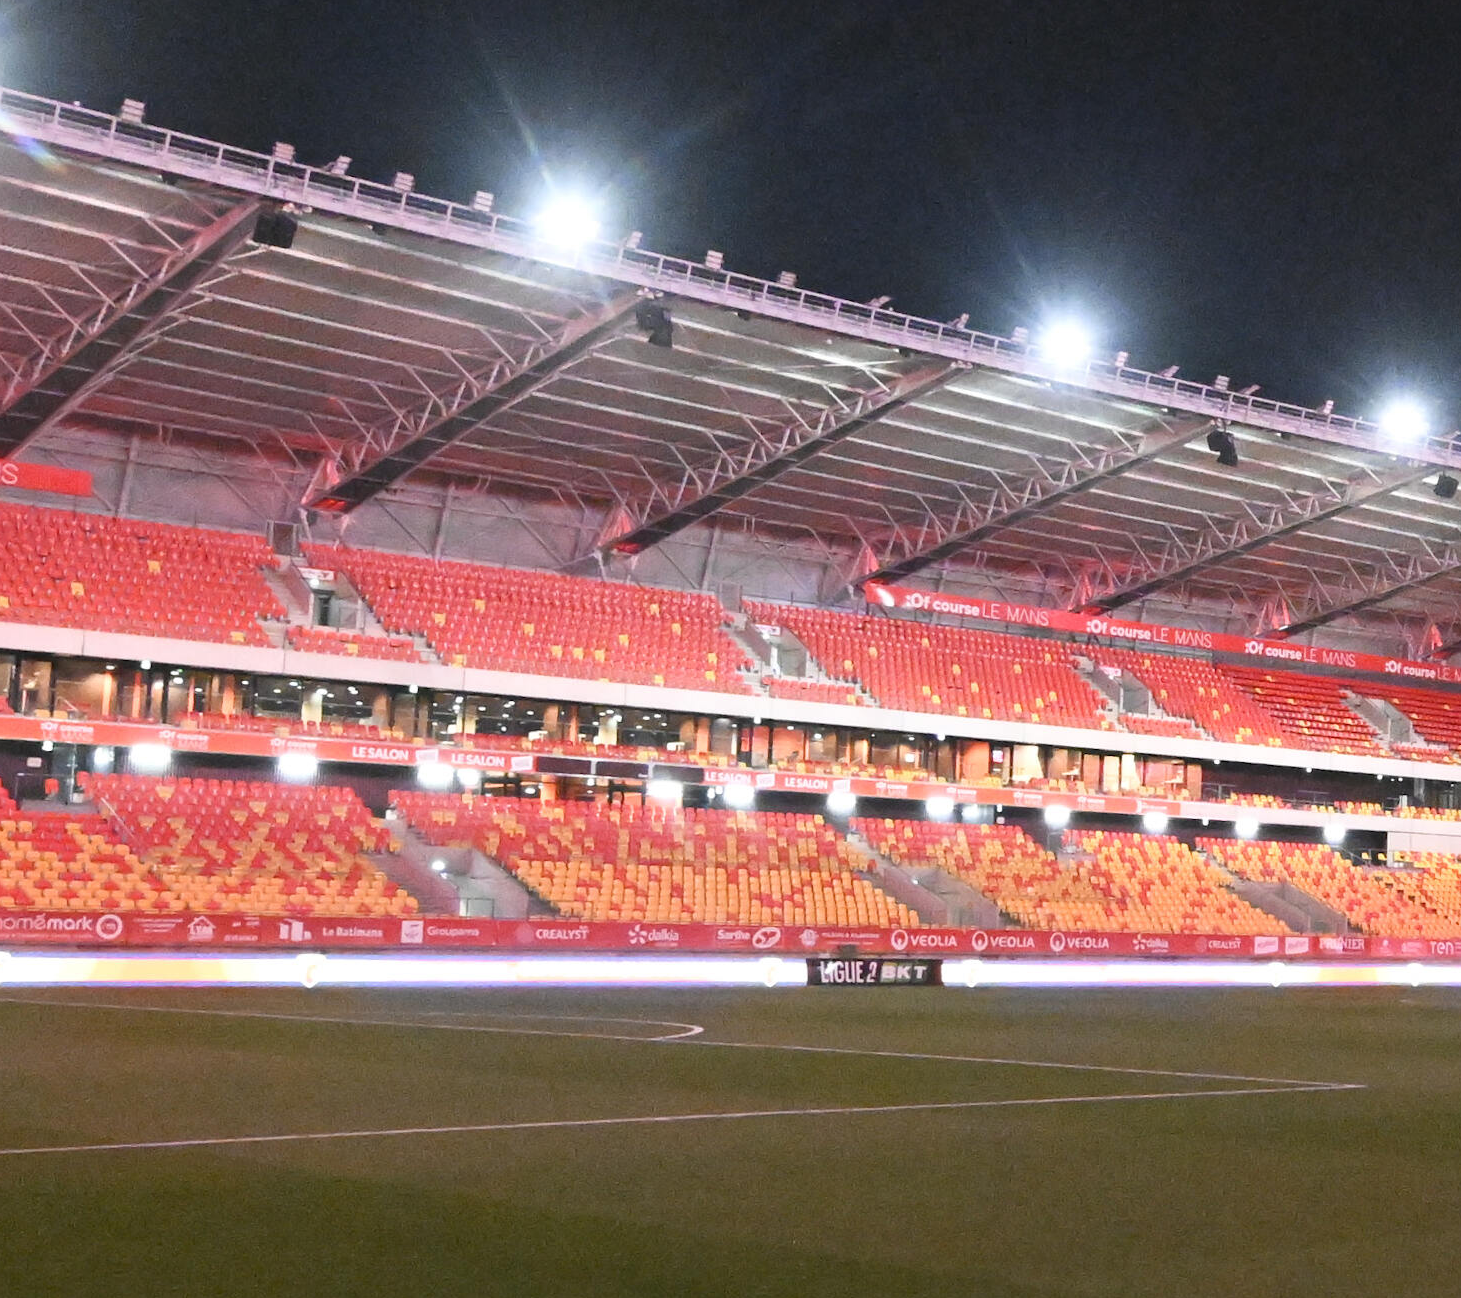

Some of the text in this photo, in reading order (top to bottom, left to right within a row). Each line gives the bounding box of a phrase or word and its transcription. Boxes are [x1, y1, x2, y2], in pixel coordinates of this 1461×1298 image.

[932, 600, 979, 617] course
[982, 603, 1000, 619] LE
[1007, 606, 1049, 626] MANS
[1109, 624, 1151, 641] course
[1153, 626, 1169, 642] LE
[1174, 630, 1212, 649] MANS
[1265, 646, 1302, 661] course
[1303, 648, 1317, 663] LE
[1322, 651, 1356, 669] MANS
[1403, 665, 1436, 680] course
[1437, 666, 1450, 681] LE
[352, 746, 367, 758] LE
[368, 747, 409, 760] SALON
[451, 753, 466, 765] LE
[467, 754, 505, 767] SALON
[785, 776, 828, 789] LE SALON
[535, 928, 588, 940] CREALYST
[648, 928, 679, 942] dalkia
[717, 929, 751, 941] Sarthe
[910, 935, 958, 947] VEOLIA
[990, 936, 1035, 948] VEOLIA
[1067, 937, 1109, 949] VEOLIA
[819, 960, 927, 983] LIGUE 2 BKT
